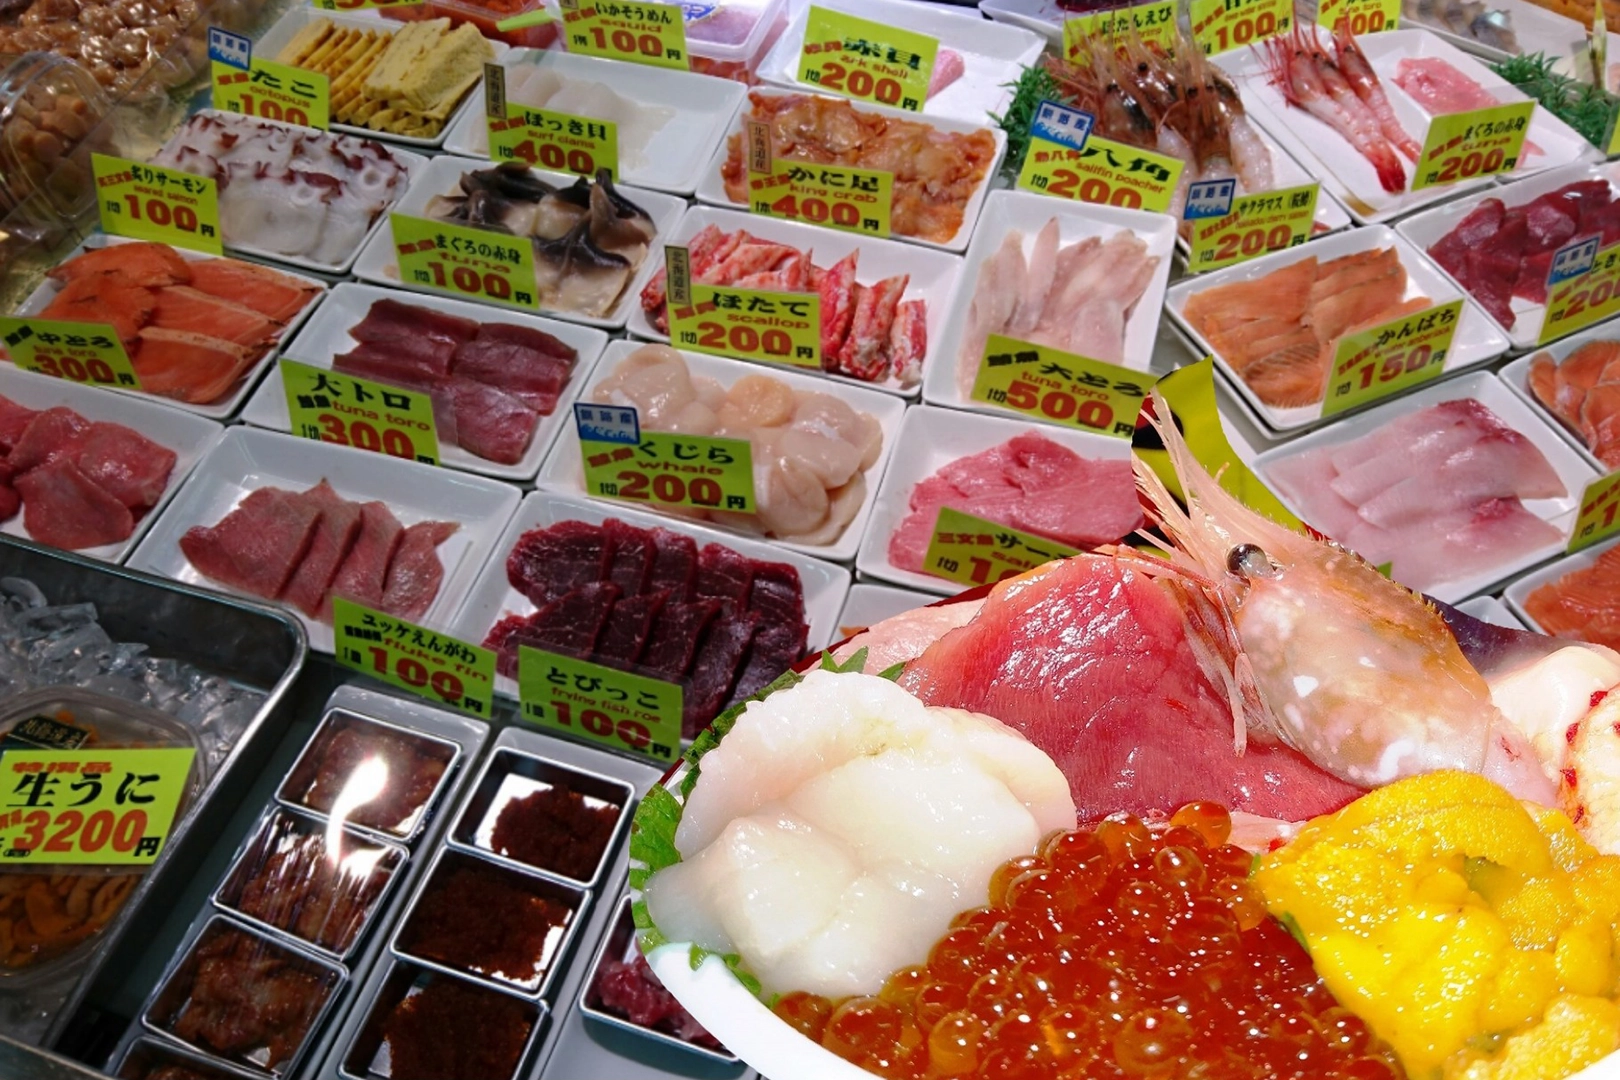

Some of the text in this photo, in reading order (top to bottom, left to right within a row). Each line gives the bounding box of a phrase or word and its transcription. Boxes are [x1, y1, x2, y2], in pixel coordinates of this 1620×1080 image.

[596, 2, 672, 24] いかそうめん
[600, 18, 662, 33] squid
[251, 70, 317, 99] たこ
[873, 64, 908, 79] shell
[240, 93, 325, 131] 100
[525, 111, 607, 141] ほっき貝
[528, 130, 596, 149] surf clams
[1079, 145, 1171, 182] 八角
[788, 166, 879, 192] かに足
[1047, 169, 1159, 213] 200
[1115, 173, 1166, 194] poacher
[789, 183, 878, 203] king crab
[435, 233, 521, 264] まぐろの赤身
[438, 252, 510, 274] tuna
[712, 291, 810, 317] ほたて
[727, 313, 810, 329] scallop
[36, 332, 114, 349] 中とろ
[308, 373, 411, 411] 大トロ
[1021, 371, 1110, 401] tuna toro
[1039, 362, 1144, 397] 大とろ
[331, 400, 379, 420] tuna
[384, 413, 431, 431] toro
[638, 441, 734, 464] くじら
[636, 460, 724, 476] whale
[995, 533, 1073, 560] サー
[362, 613, 476, 664] ユッケえんがわ
[383, 637, 446, 666] fluke
[454, 663, 488, 682] fin
[546, 666, 660, 710] とびっこ
[602, 700, 630, 715] fish
[632, 710, 662, 725] roe
[6, 772, 161, 808] 生うに
